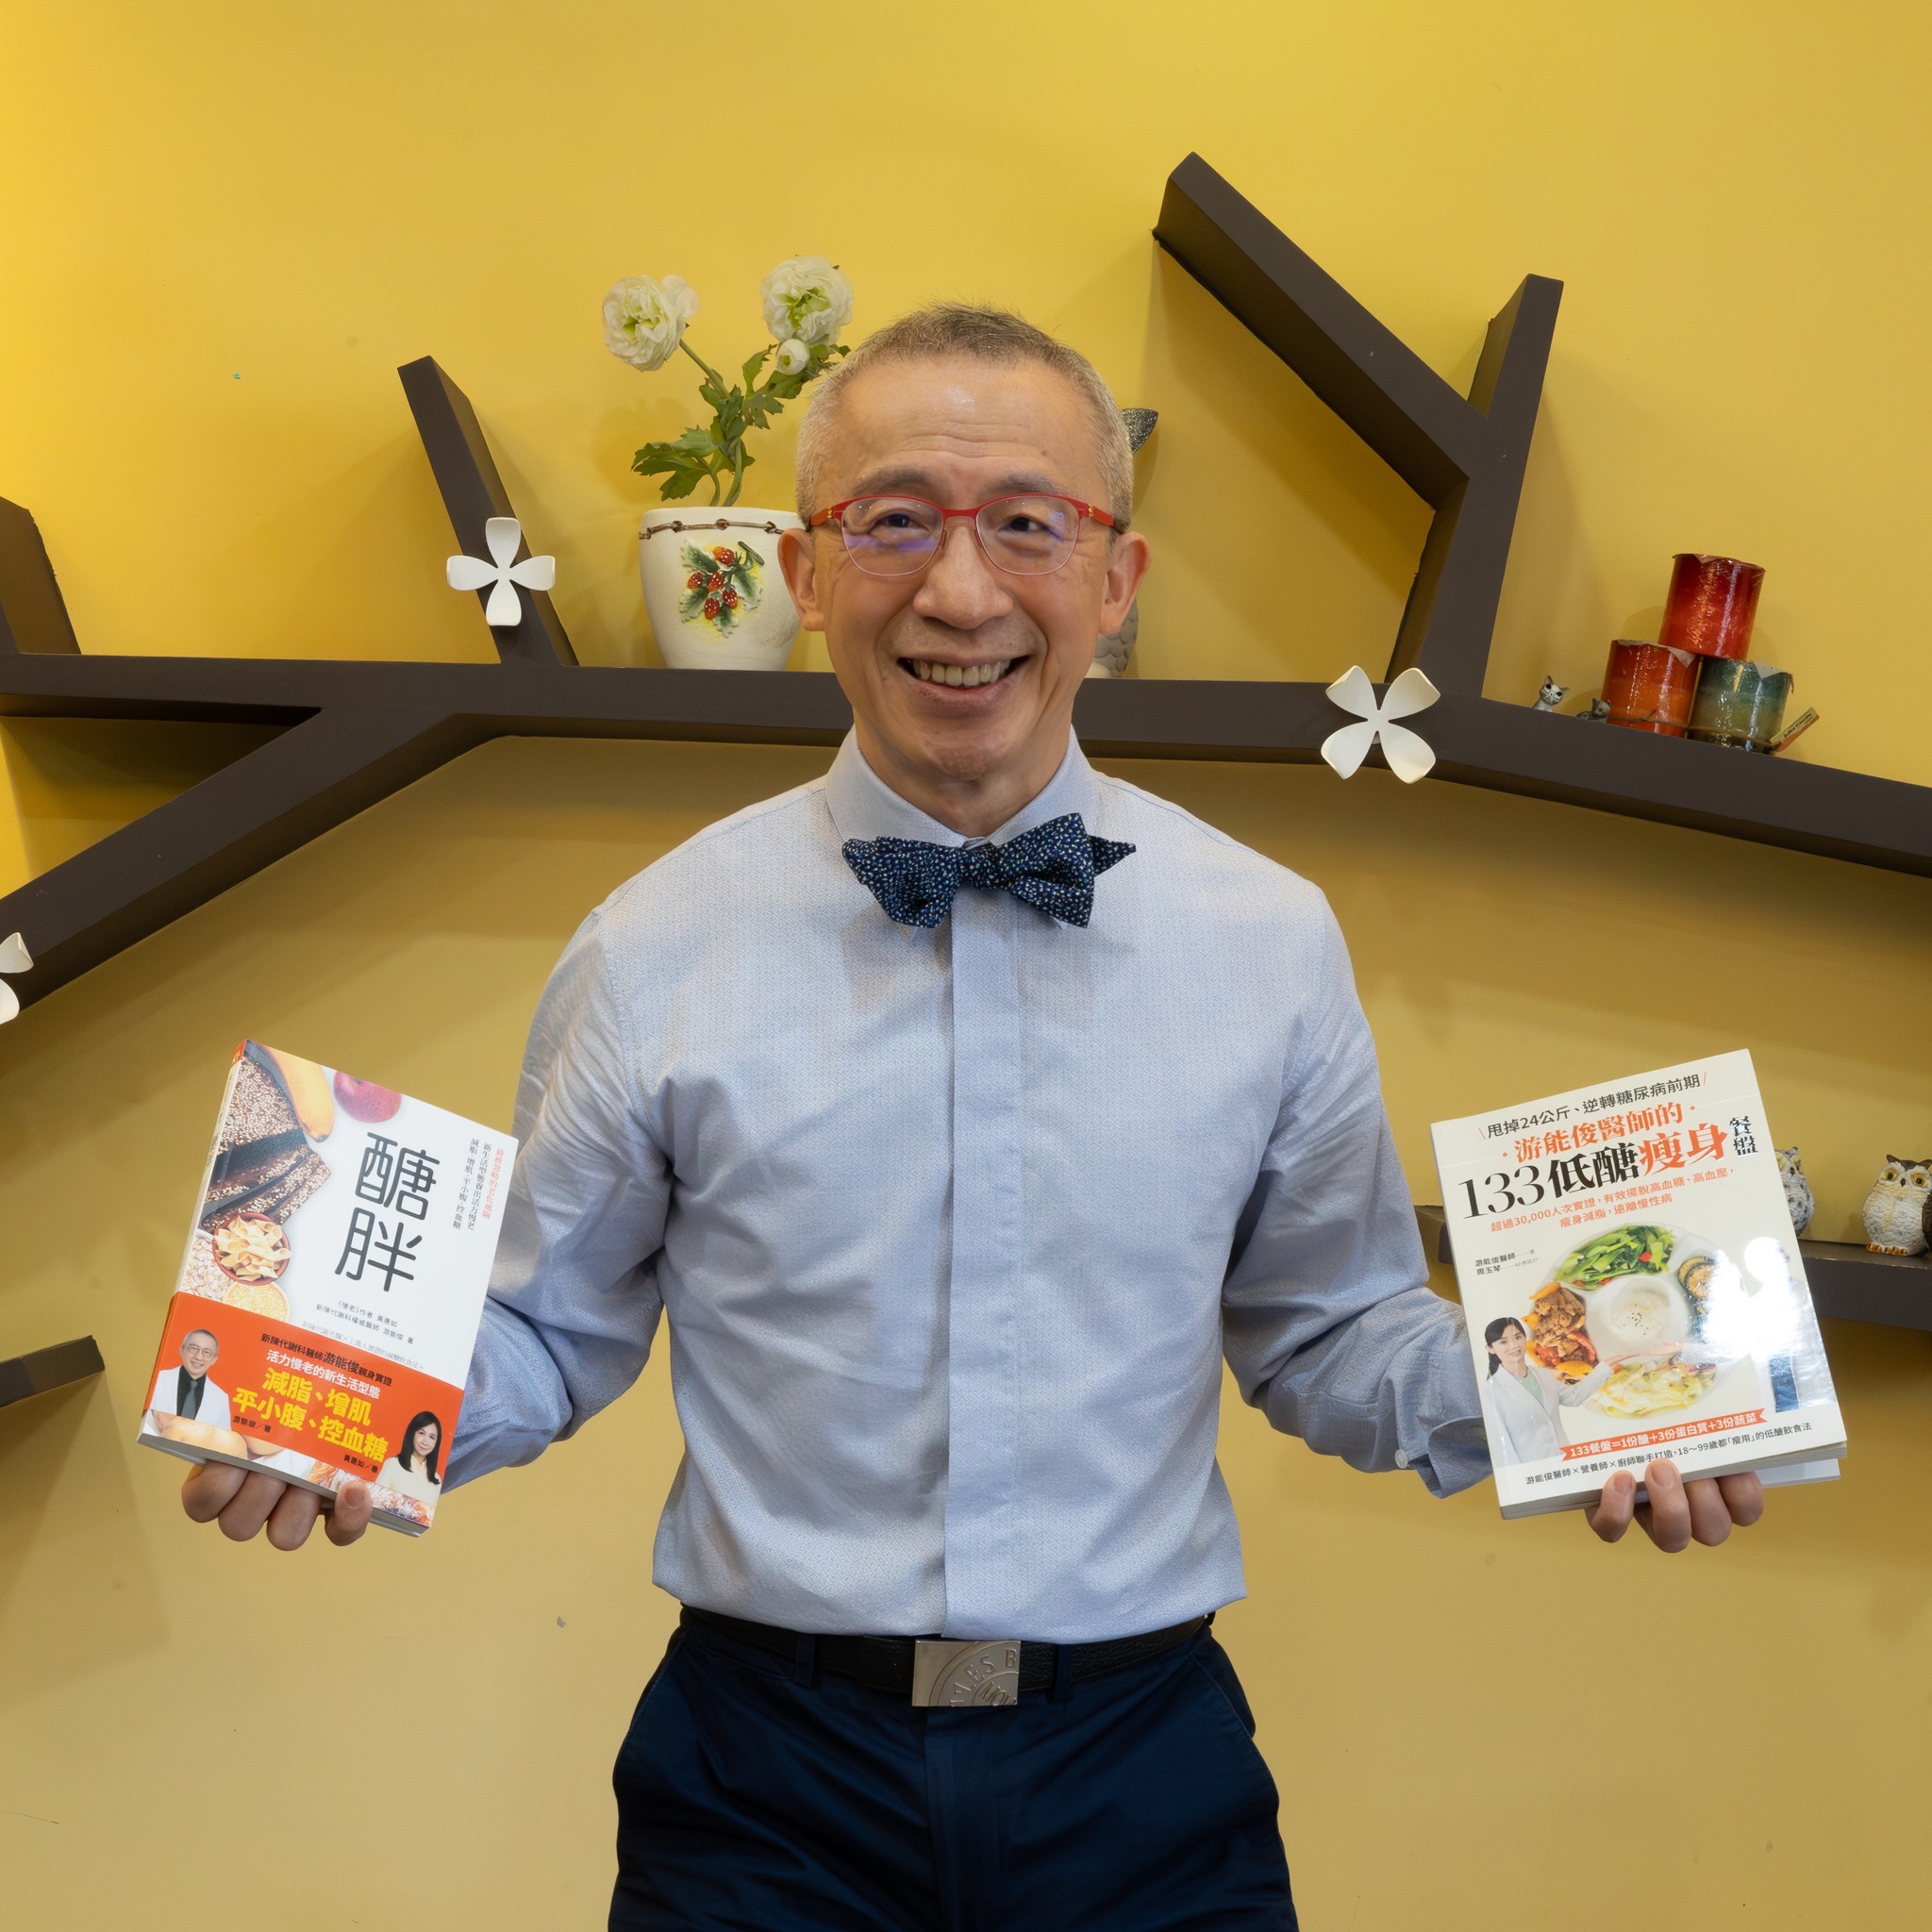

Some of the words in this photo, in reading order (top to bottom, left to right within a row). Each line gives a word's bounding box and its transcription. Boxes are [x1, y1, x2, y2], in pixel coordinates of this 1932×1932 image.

[1487, 1074, 1701, 1139] 甩掉24公斤、逆轉糖尿病前期
[1514, 1101, 1683, 1163] 游能俊醫師的
[334, 1131, 441, 1292] 醣胖
[262, 1366, 373, 1426] 減脂、增肌
[266, 1349, 381, 1400] 活力慢老的新生活型態
[232, 1387, 390, 1463] 平小腹、控血糖
